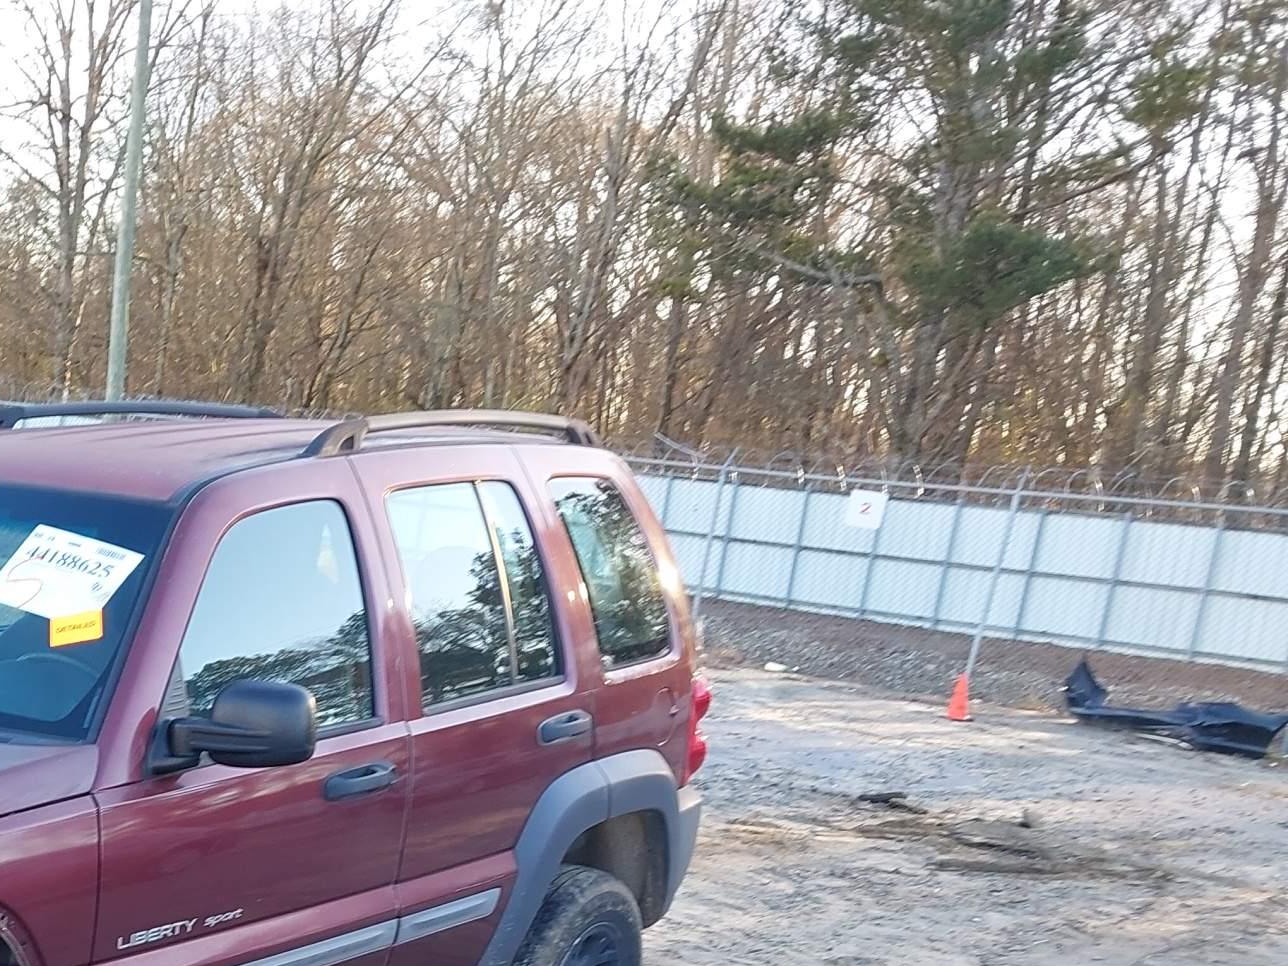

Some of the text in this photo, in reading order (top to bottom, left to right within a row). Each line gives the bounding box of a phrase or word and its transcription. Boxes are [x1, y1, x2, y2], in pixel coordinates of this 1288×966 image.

[25, 545, 115, 578] 44188625
[117, 908, 244, 949] LIBERTY sport
